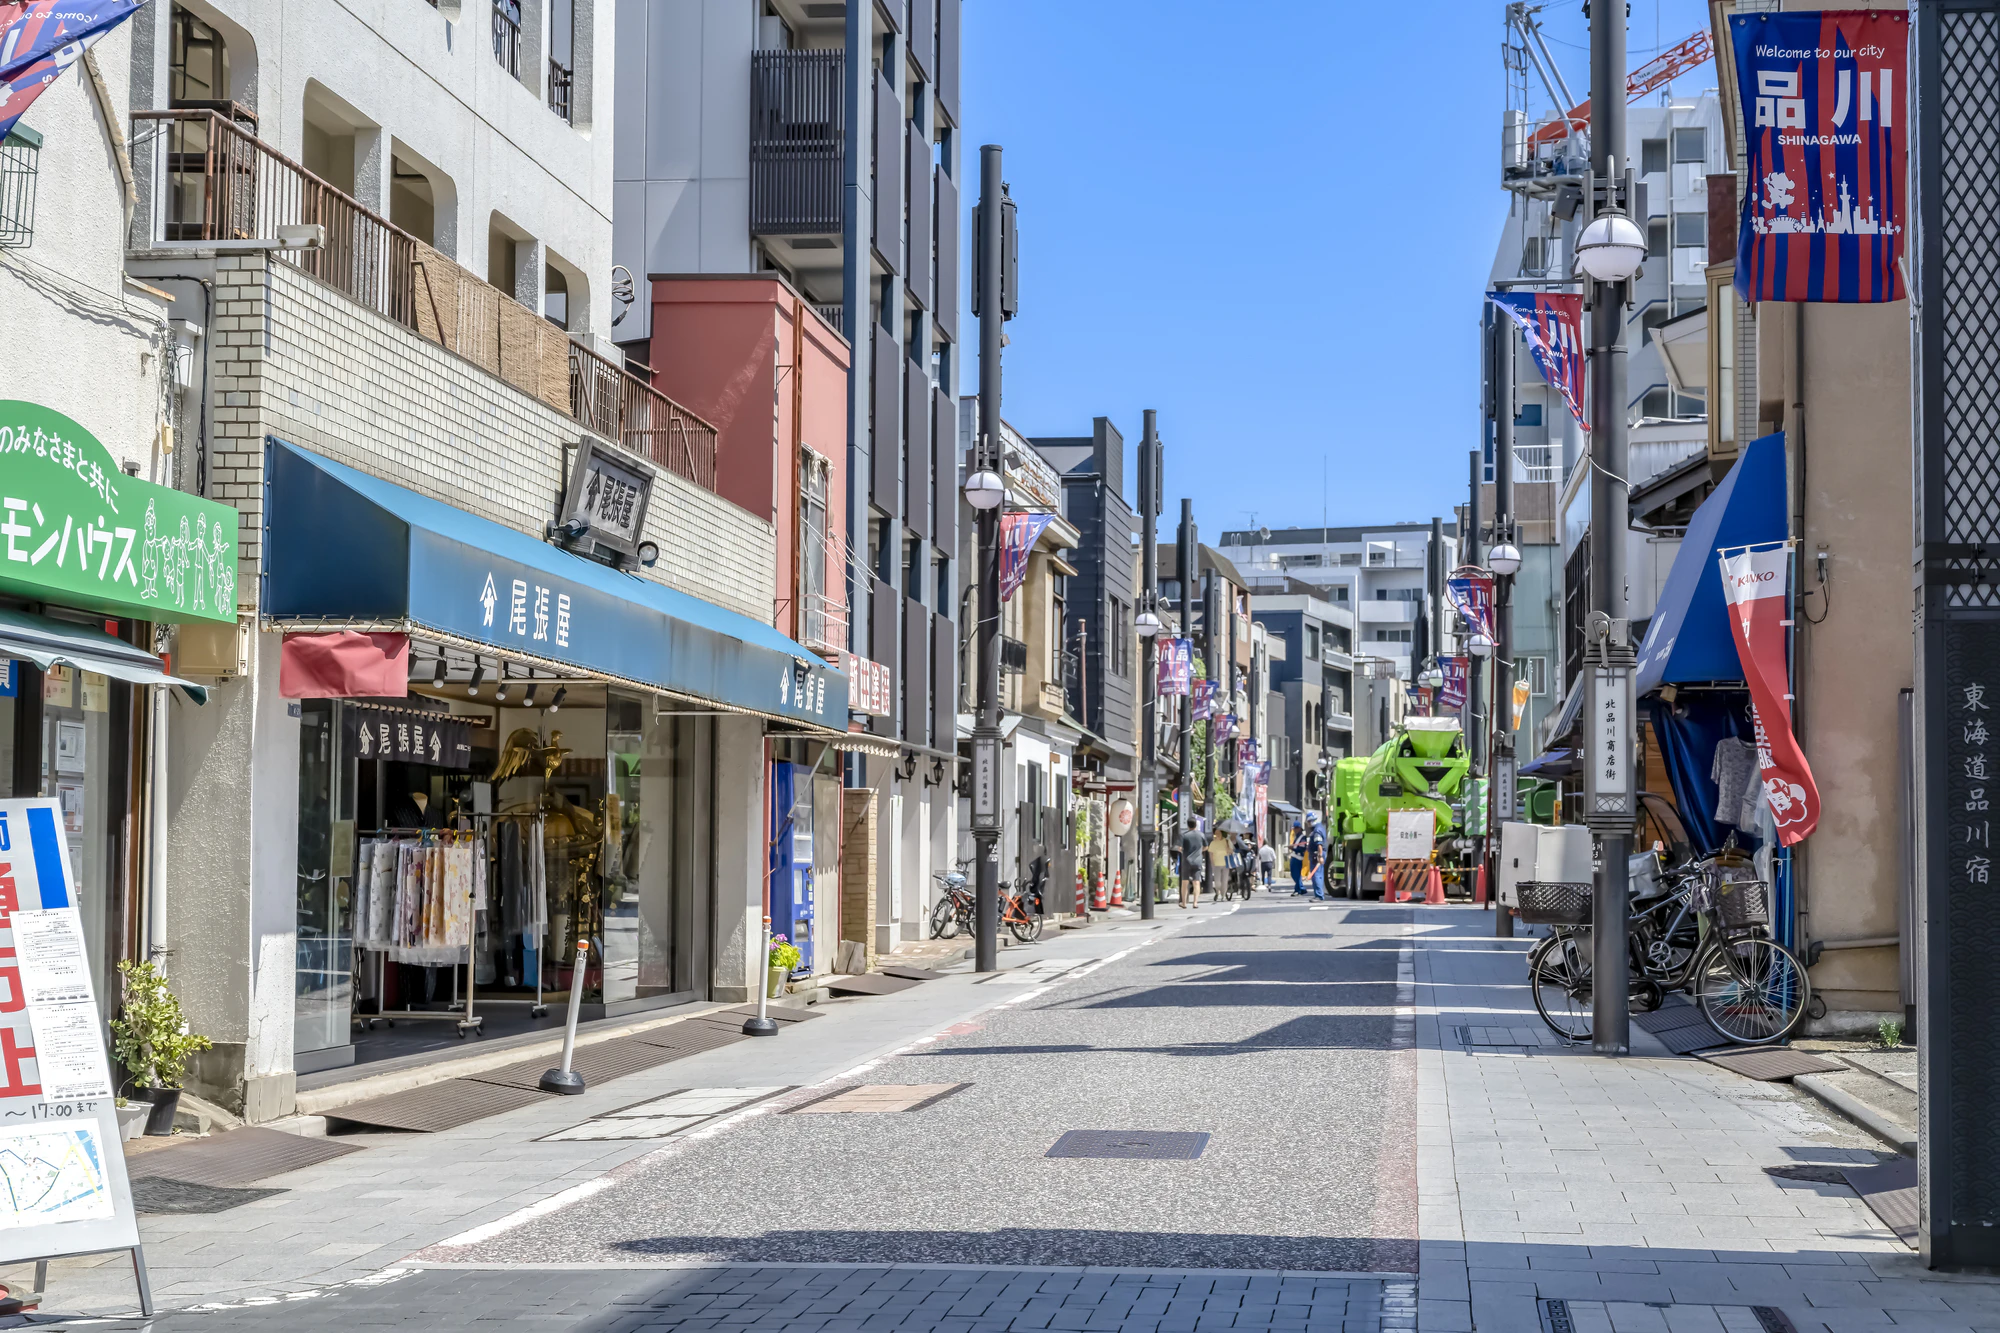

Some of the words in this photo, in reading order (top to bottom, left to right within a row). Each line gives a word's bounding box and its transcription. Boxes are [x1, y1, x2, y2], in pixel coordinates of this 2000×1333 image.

[1755, 44, 1811, 58] Welcome
[1814, 47, 1830, 58] to
[1833, 48, 1856, 58] our
[1859, 44, 1885, 59] city
[1754, 68, 1893, 129] 品川
[1777, 134, 1862, 145] SHINAGAWA
[0, 425, 119, 514] のみなさまと共に
[596, 475, 637, 529] 尾張屋
[1, 497, 138, 587] モンハウス
[1737, 571, 1775, 588] KANKO
[508, 578, 571, 648] 尾張屋
[794, 669, 825, 715] 尾張屋
[378, 723, 425, 755] 尾張屋
[1605, 698, 1616, 780] 北品川商店街
[1962, 682, 1990, 884] 東海道品川宿
